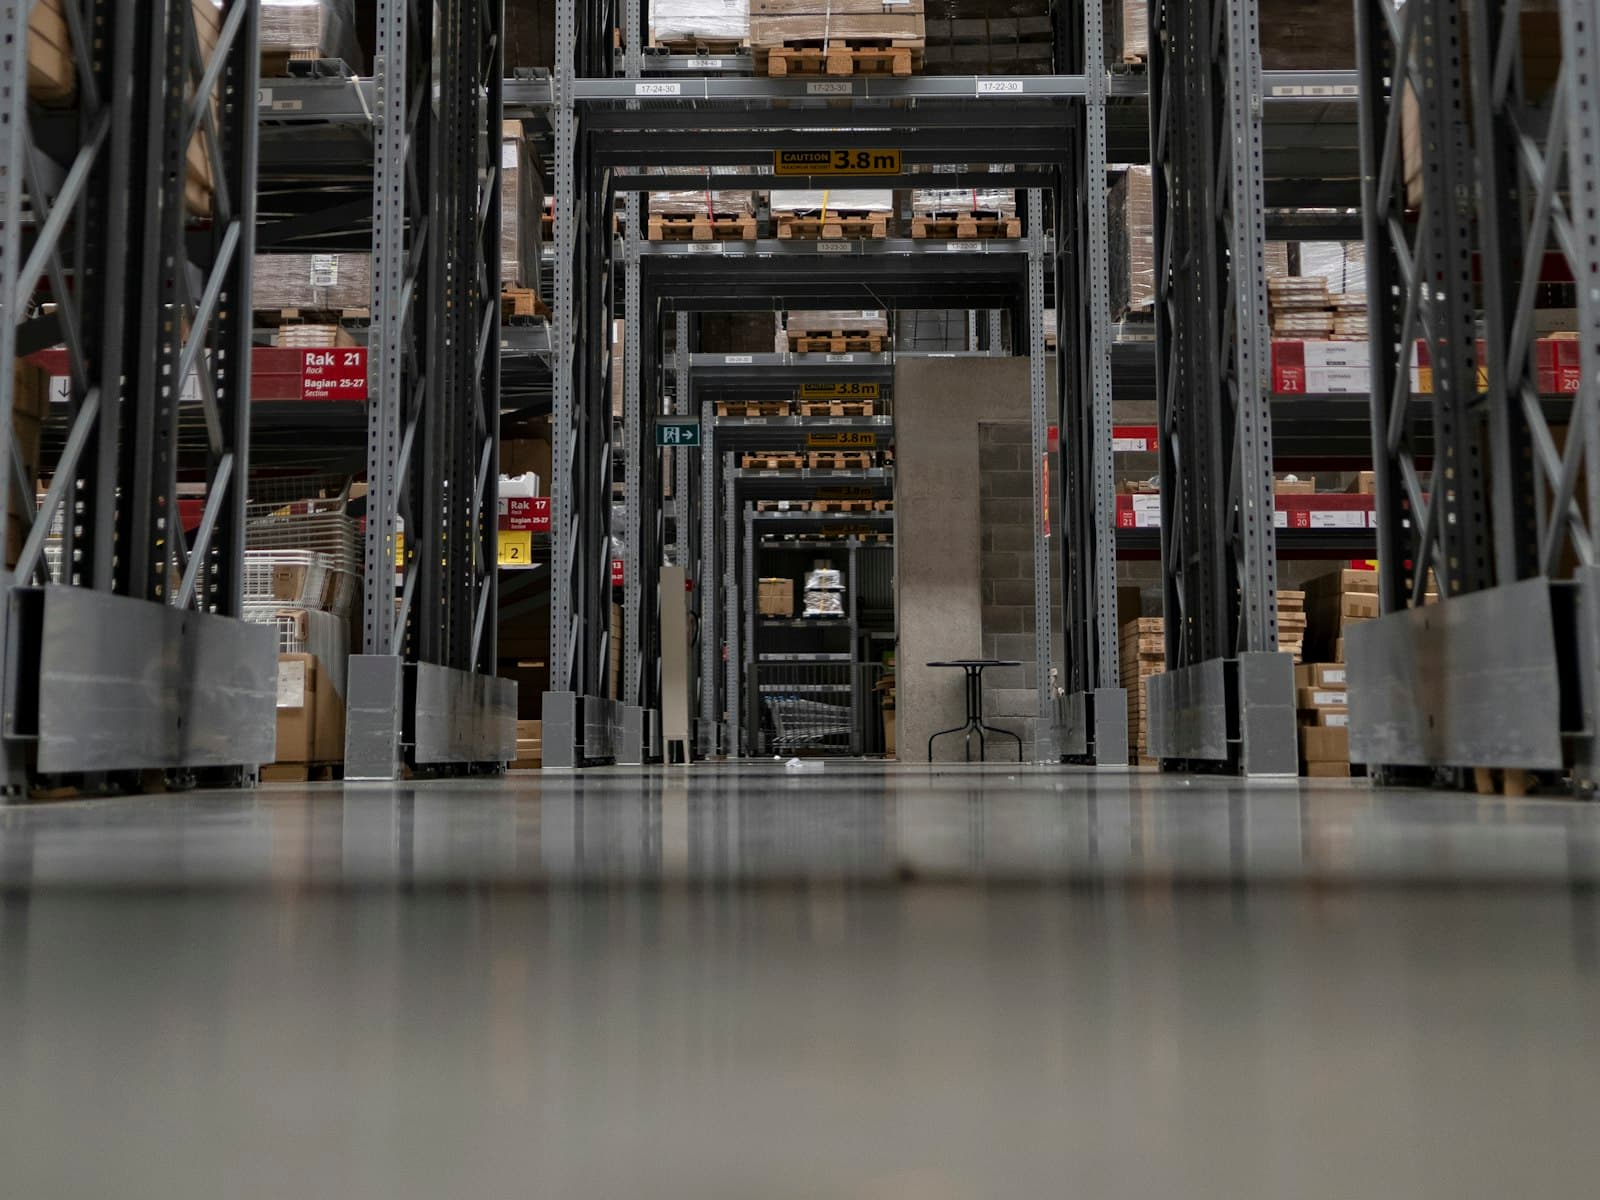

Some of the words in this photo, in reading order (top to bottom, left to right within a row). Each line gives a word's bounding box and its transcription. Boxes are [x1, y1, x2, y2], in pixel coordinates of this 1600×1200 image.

[983, 82, 1018, 90] 17-22-30
[783, 153, 829, 162] CAUTION
[305, 351, 335, 366] Rak
[343, 352, 360, 366] 21
[304, 379, 337, 390] Bagian
[339, 379, 365, 388] 25-27
[1282, 379, 1298, 391] 21
[1564, 378, 1580, 390] 20
[511, 500, 530, 510] Rak
[535, 500, 546, 510] 17
[1123, 518, 1133, 526] 21
[1296, 518, 1308, 527] 20
[511, 547, 519, 559] 2
